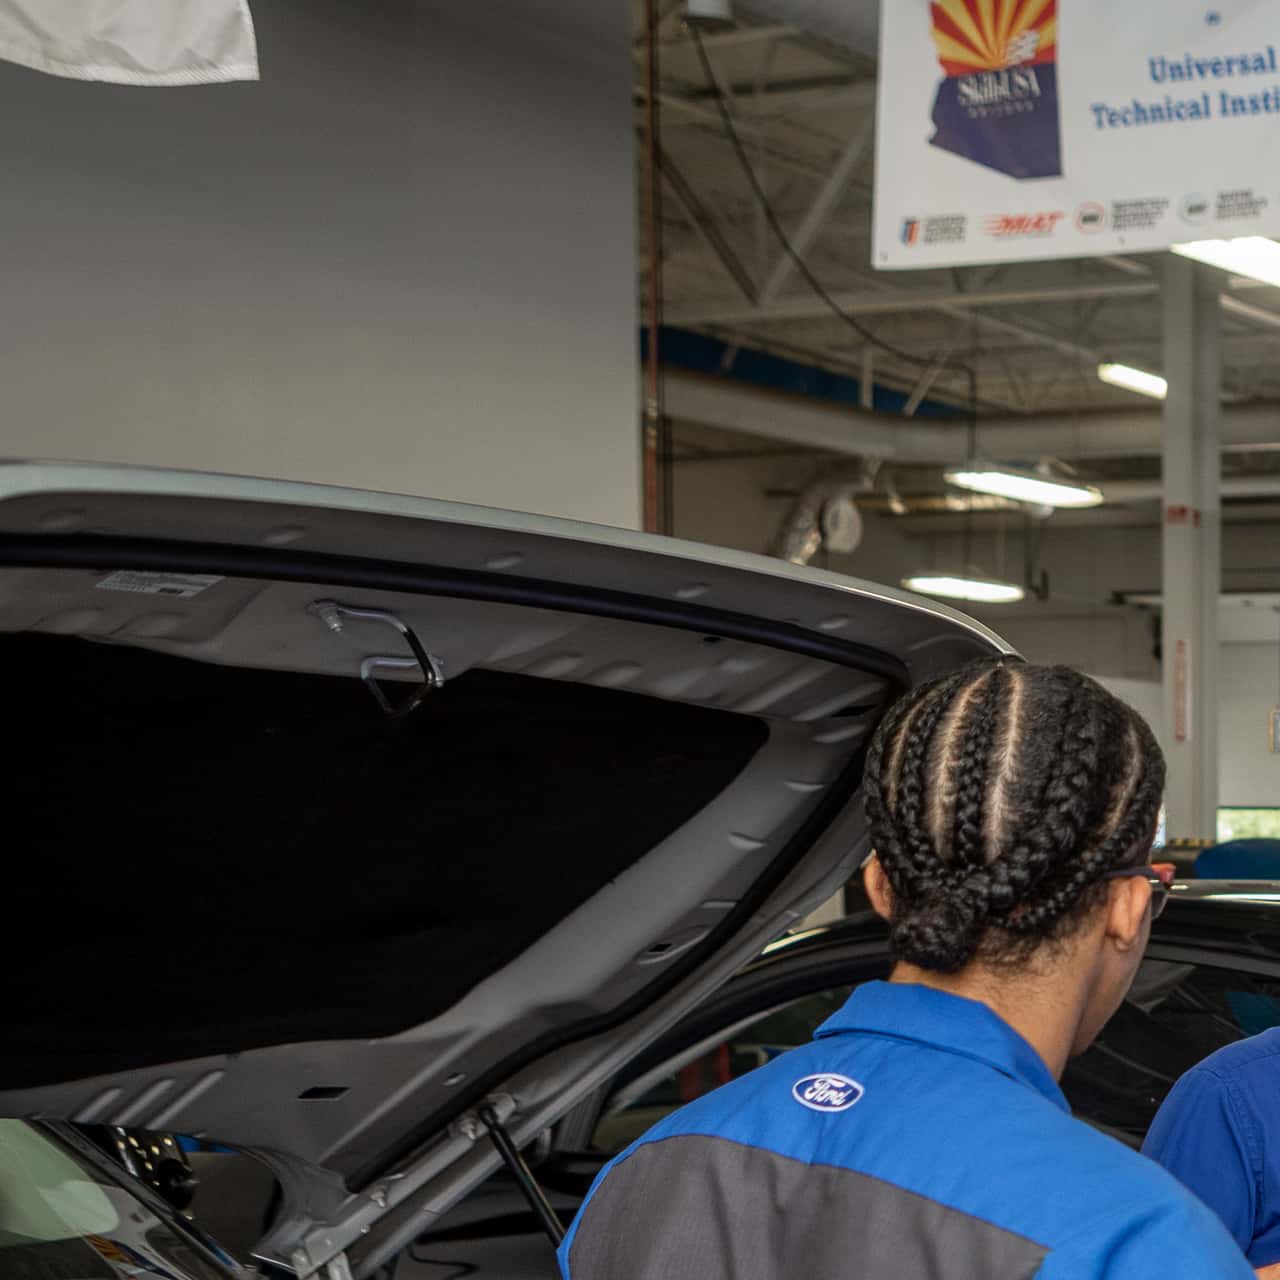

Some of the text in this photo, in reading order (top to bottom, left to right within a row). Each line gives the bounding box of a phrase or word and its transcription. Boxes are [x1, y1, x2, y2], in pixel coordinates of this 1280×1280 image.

[1148, 46, 1278, 84] Universal
[1090, 93, 1211, 130] Technical
[802, 1077, 856, 1106] Ford
